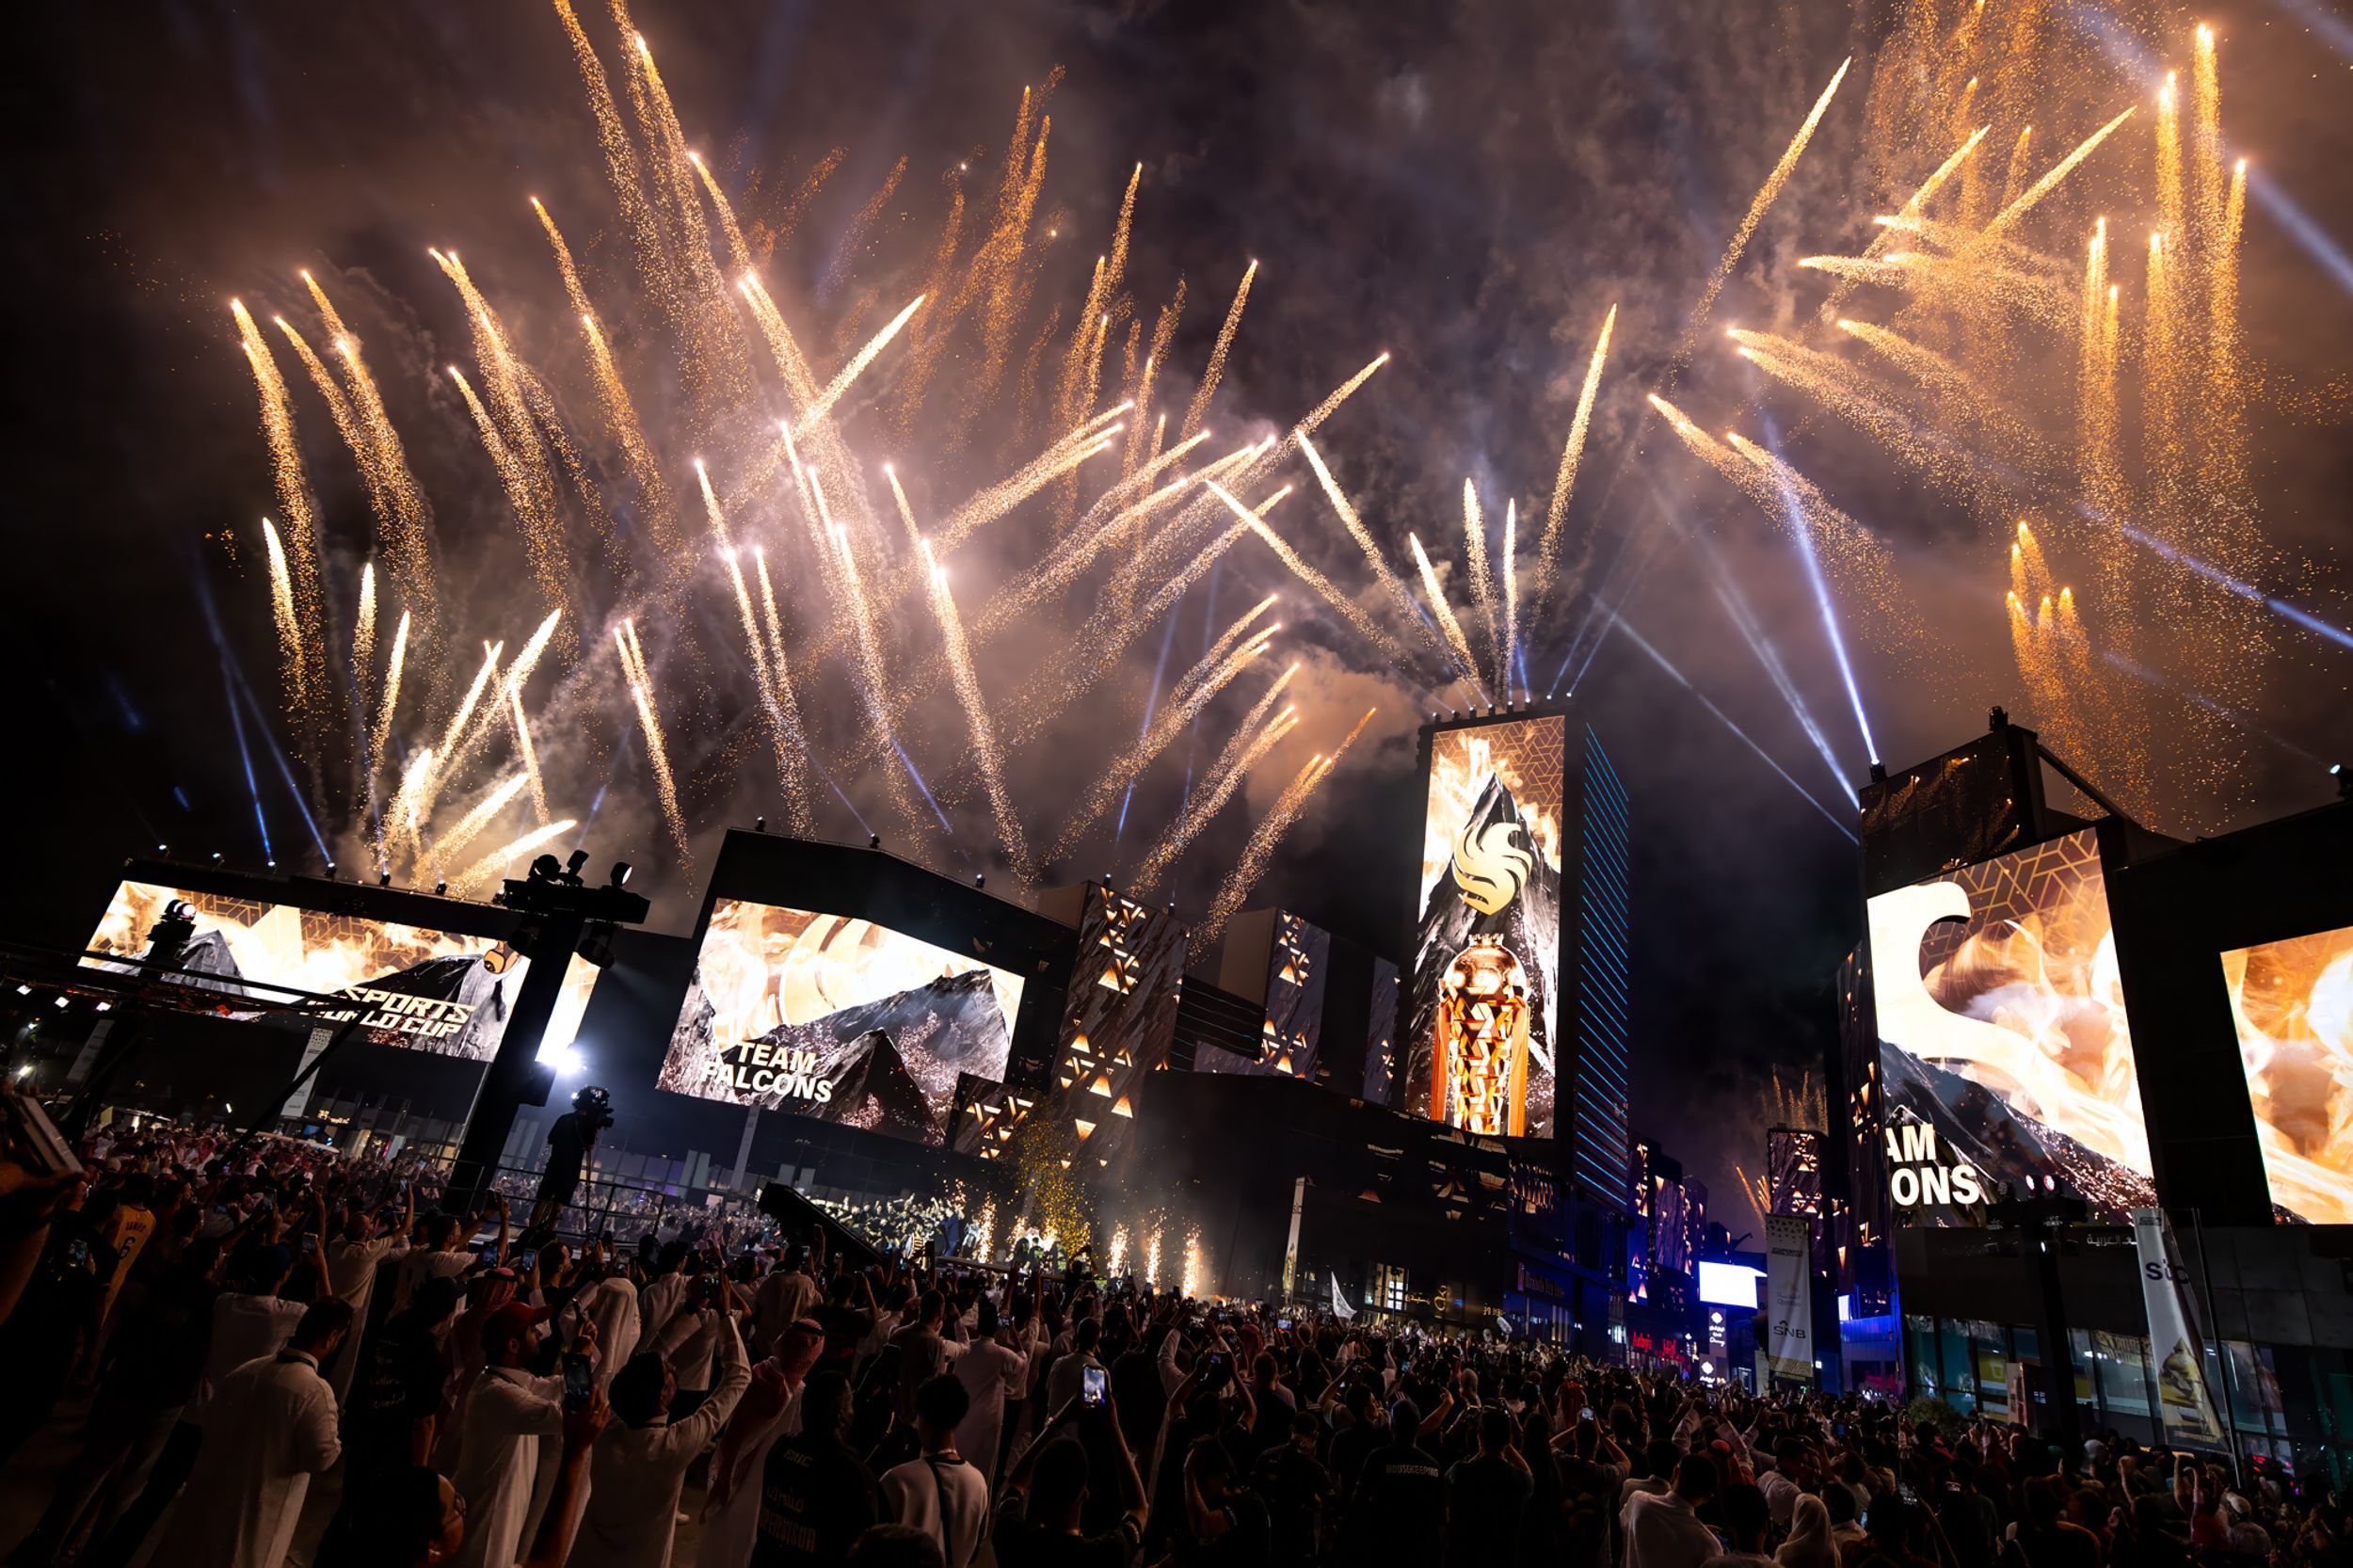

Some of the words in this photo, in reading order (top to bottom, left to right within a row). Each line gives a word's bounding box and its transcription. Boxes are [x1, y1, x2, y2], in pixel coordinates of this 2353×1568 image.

[299, 1000, 402, 1029] ORLD
[399, 1018, 463, 1038] CUP
[328, 986, 476, 1024] SPORTS
[737, 1042, 817, 1074] TEAM
[699, 1061, 834, 1103] FALCONS
[1885, 1124, 1937, 1162] AM
[1891, 1164, 1980, 1206] ONS
[119, 1236, 136, 1259] 6
[1773, 1325, 1806, 1338] SNB
